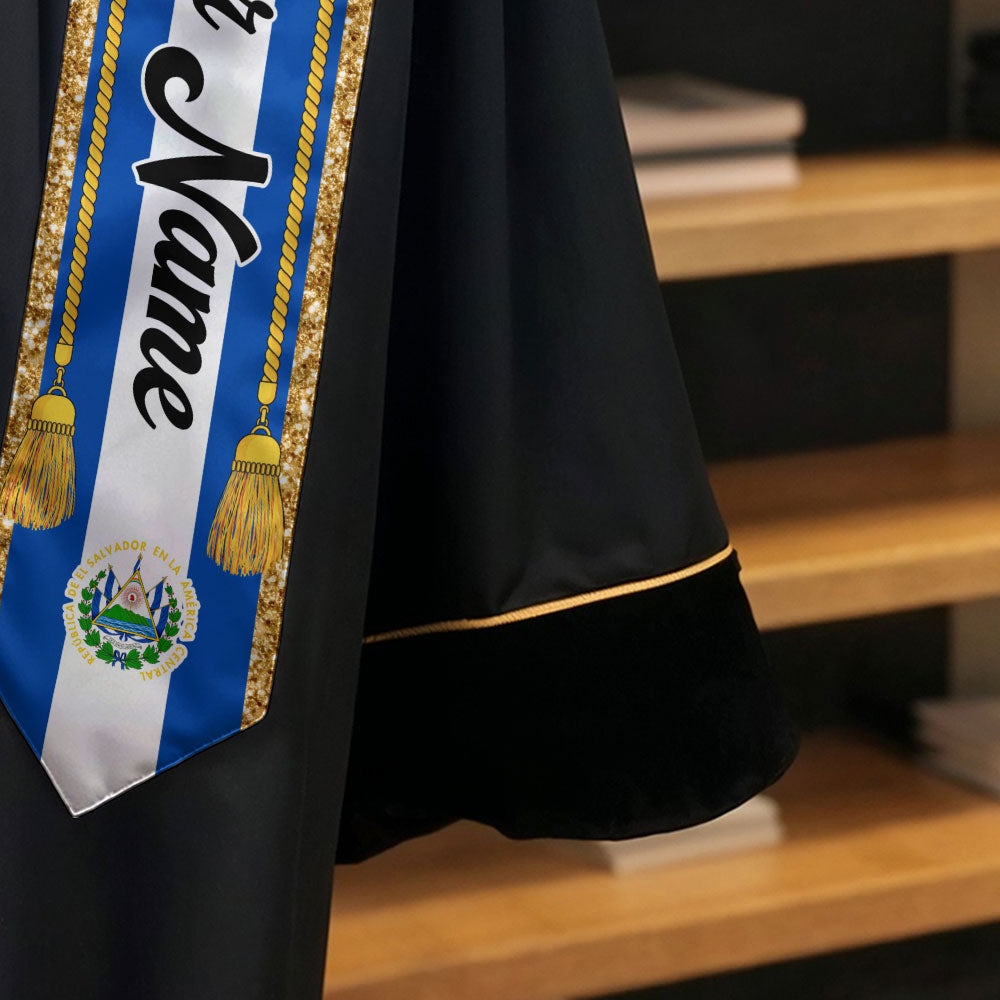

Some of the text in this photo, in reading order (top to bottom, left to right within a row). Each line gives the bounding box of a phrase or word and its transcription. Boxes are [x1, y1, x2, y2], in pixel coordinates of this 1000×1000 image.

[133, 46, 270, 430] Name
[86, 539, 147, 569] SALVADOR
[152, 545, 170, 562] EN
[168, 557, 182, 576] LA
[66, 580, 80, 598] DE
[74, 568, 89, 581] EL
[180, 580, 199, 640] AMÉRICA
[66, 603, 95, 666] REPÚBLICA
[140, 646, 186, 682] CENTRAL
